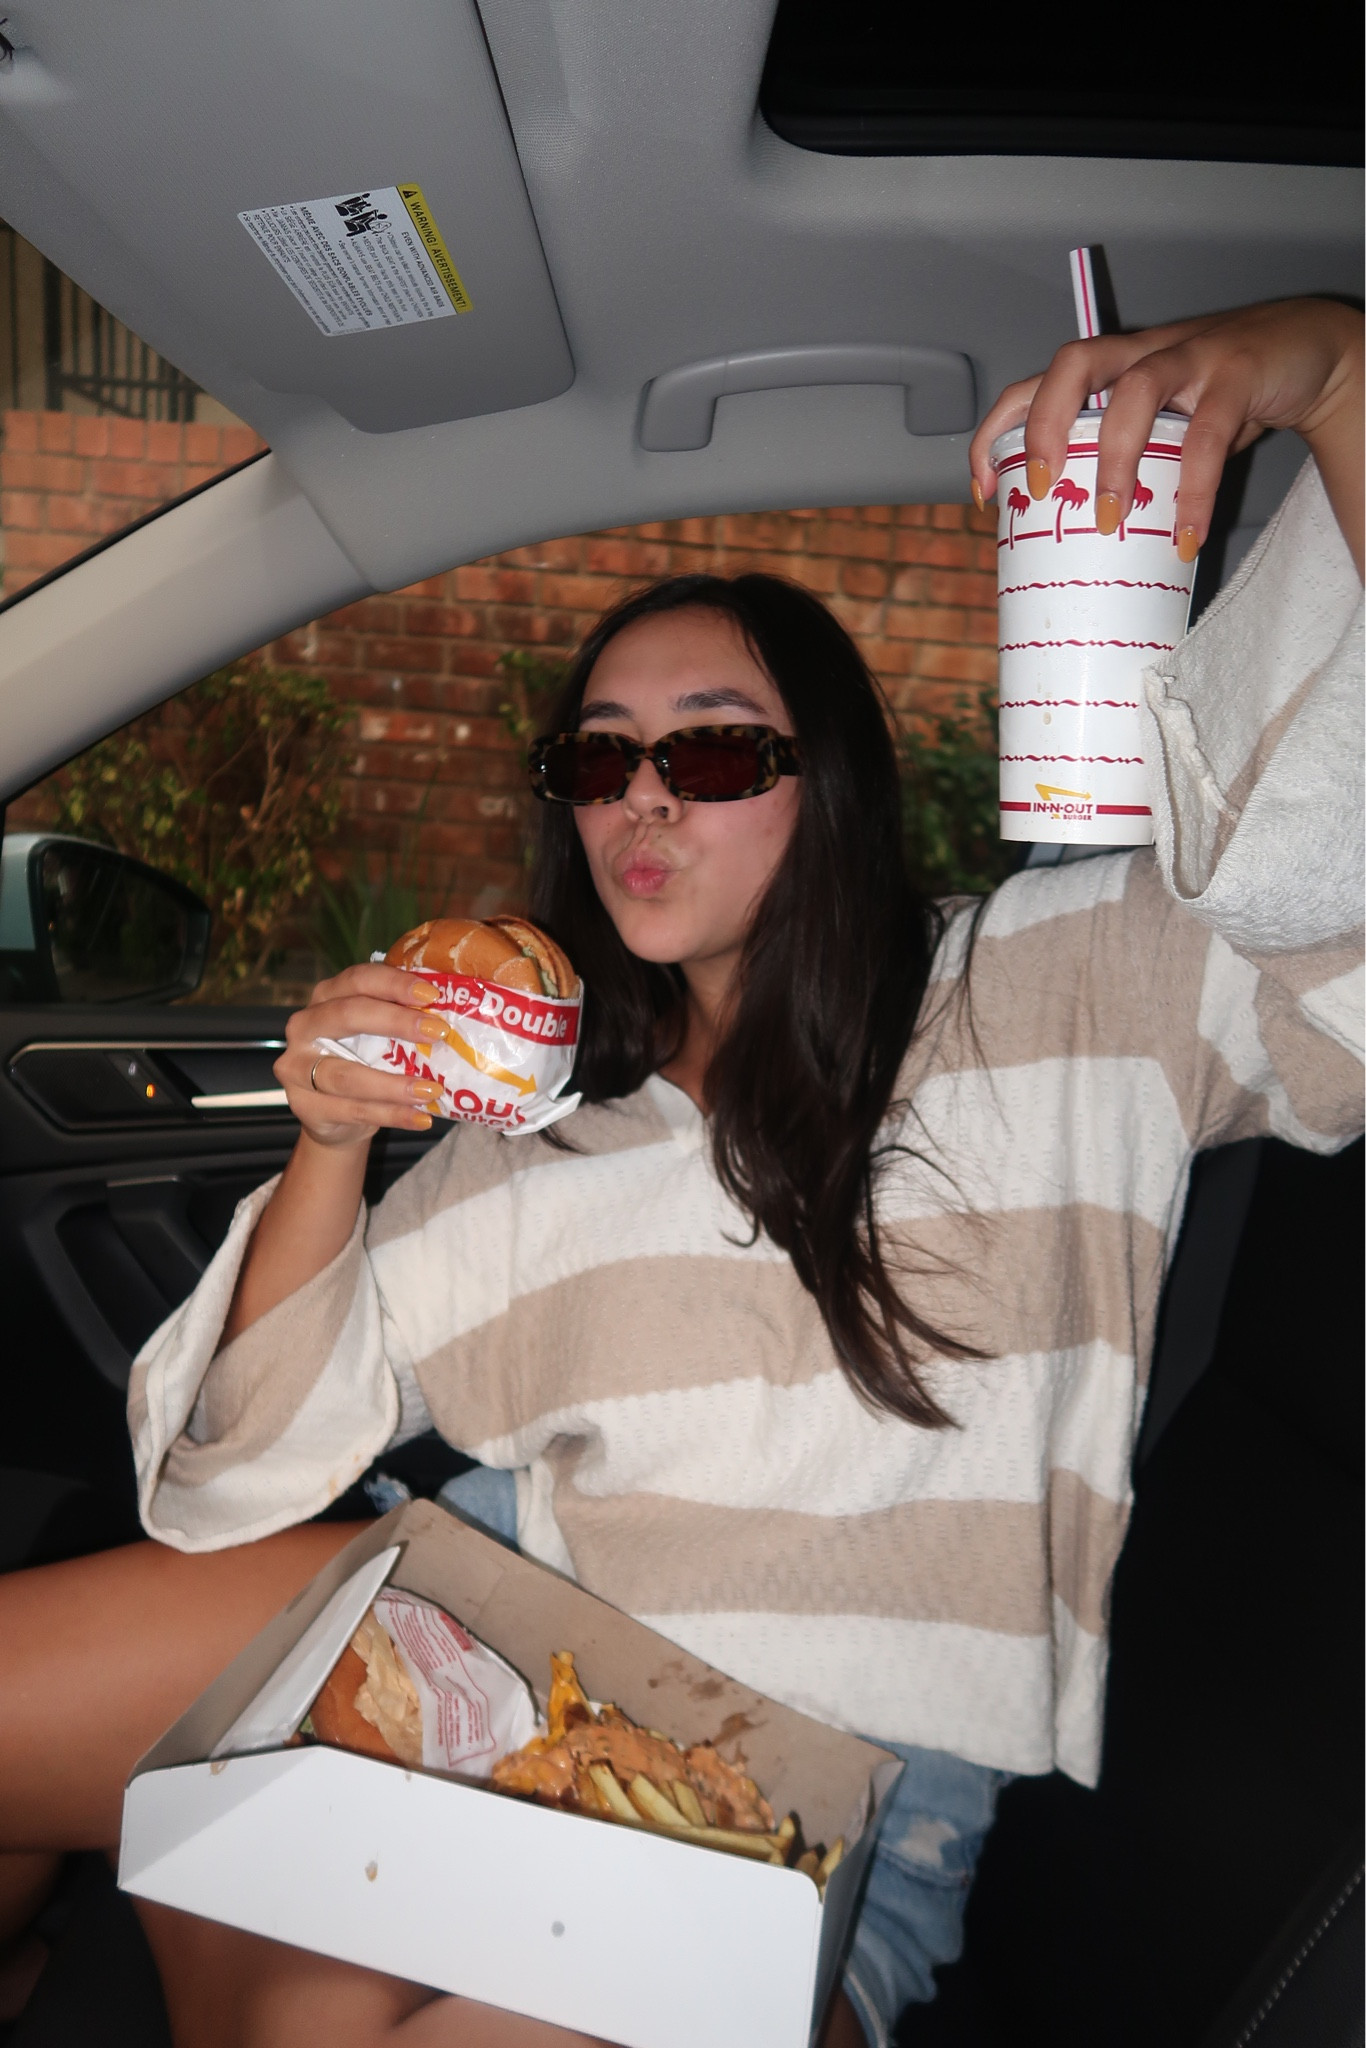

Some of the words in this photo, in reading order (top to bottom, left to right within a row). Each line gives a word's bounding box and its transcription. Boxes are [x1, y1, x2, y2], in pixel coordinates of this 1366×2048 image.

[310, 224, 326, 240] AVEC
[319, 240, 333, 251] DES
[326, 251, 342, 266] SACS
[400, 230, 415, 246] EVEN
[408, 245, 421, 260] WITH
[415, 259, 434, 286] ADVANCED
[428, 285, 439, 295] AIR
[408, 201, 439, 247] WARNING!
[430, 247, 467, 308] AVERTISSEMENT!
[1033, 802, 1093, 814] IN-N-OUT
[431, 979, 567, 1039] ble-Double
